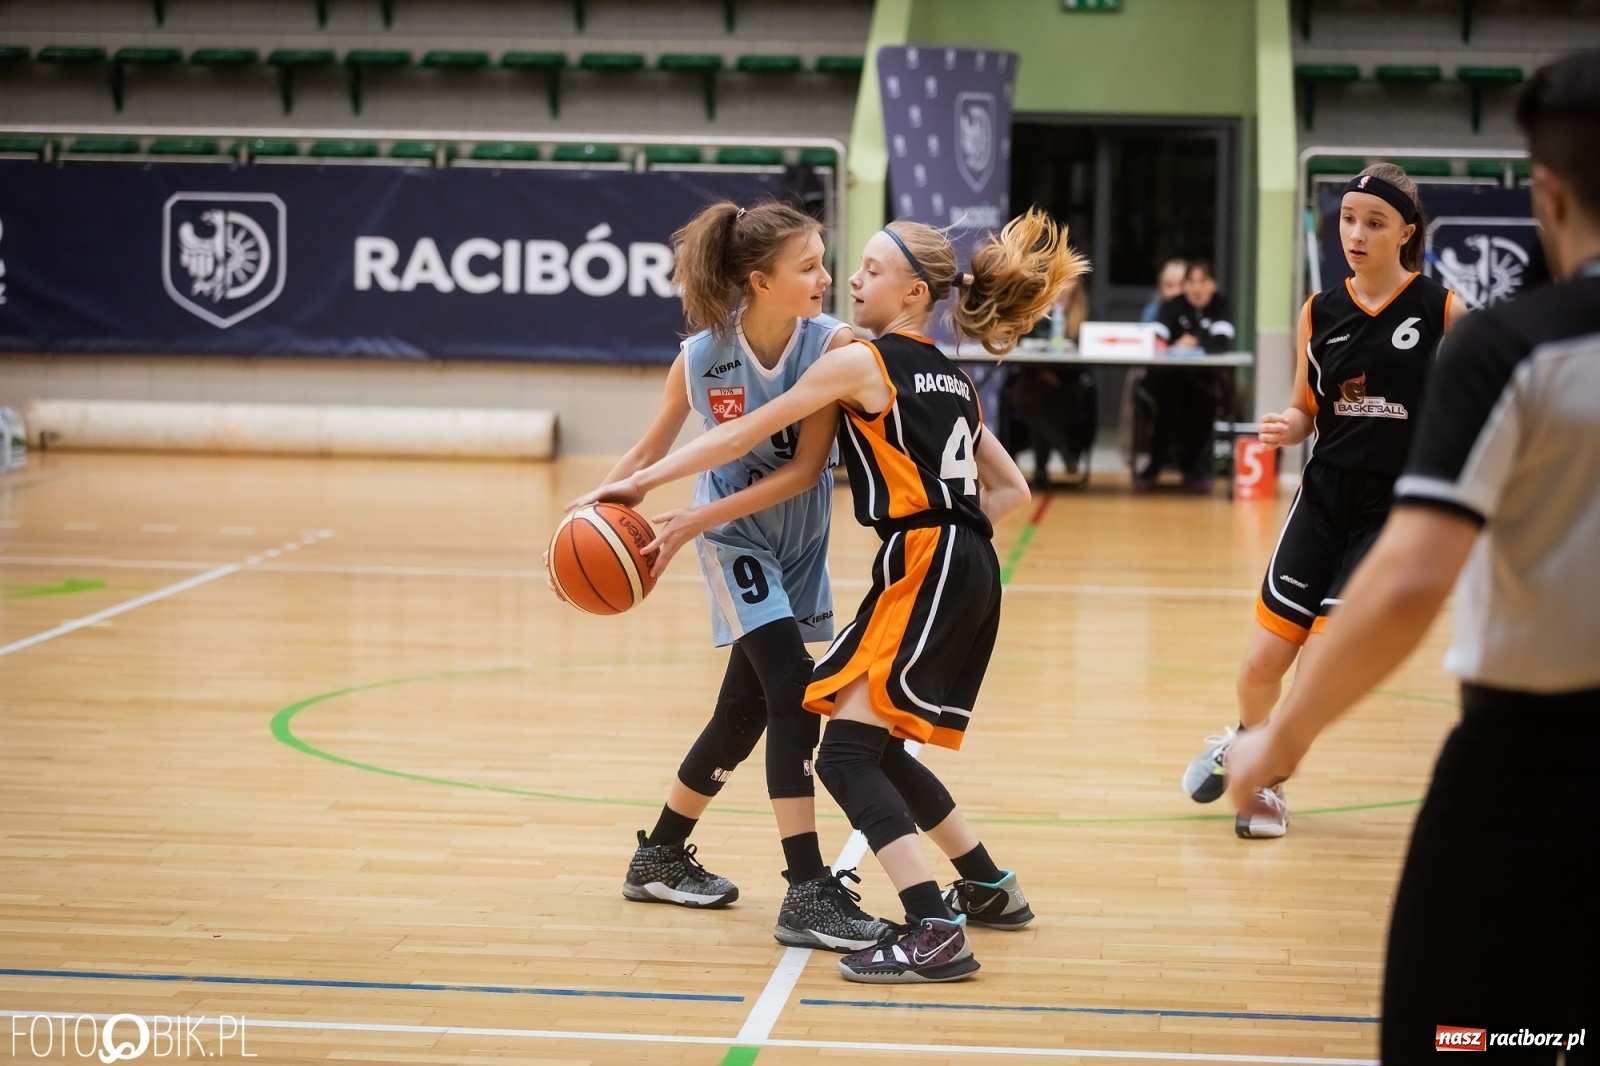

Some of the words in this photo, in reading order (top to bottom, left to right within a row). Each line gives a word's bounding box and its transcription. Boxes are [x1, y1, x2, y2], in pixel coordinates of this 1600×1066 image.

[354, 222, 685, 298] RACIBÓR
[1391, 317, 1421, 350] 6
[914, 372, 971, 402] RACIBÓRZ
[939, 416, 978, 496] 4
[1236, 442, 1264, 486] 5
[732, 554, 770, 605] 9
